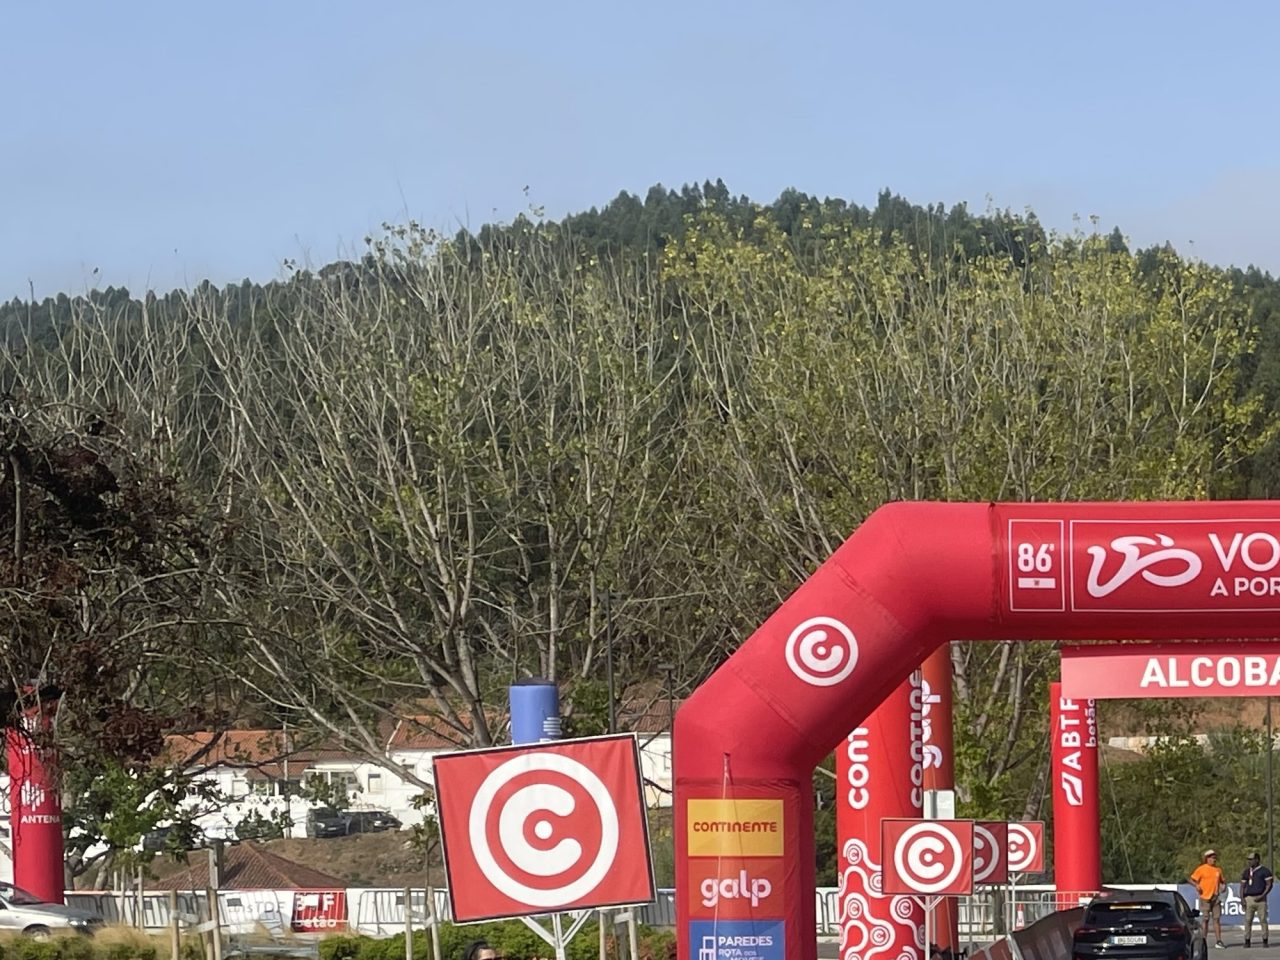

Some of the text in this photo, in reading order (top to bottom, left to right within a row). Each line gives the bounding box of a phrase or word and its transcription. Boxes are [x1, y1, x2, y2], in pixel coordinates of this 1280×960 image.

[1210, 577, 1229, 597] A
[700, 869, 772, 908] galp
[718, 935, 774, 947] PAREDES
[718, 948, 743, 958] ROTA
